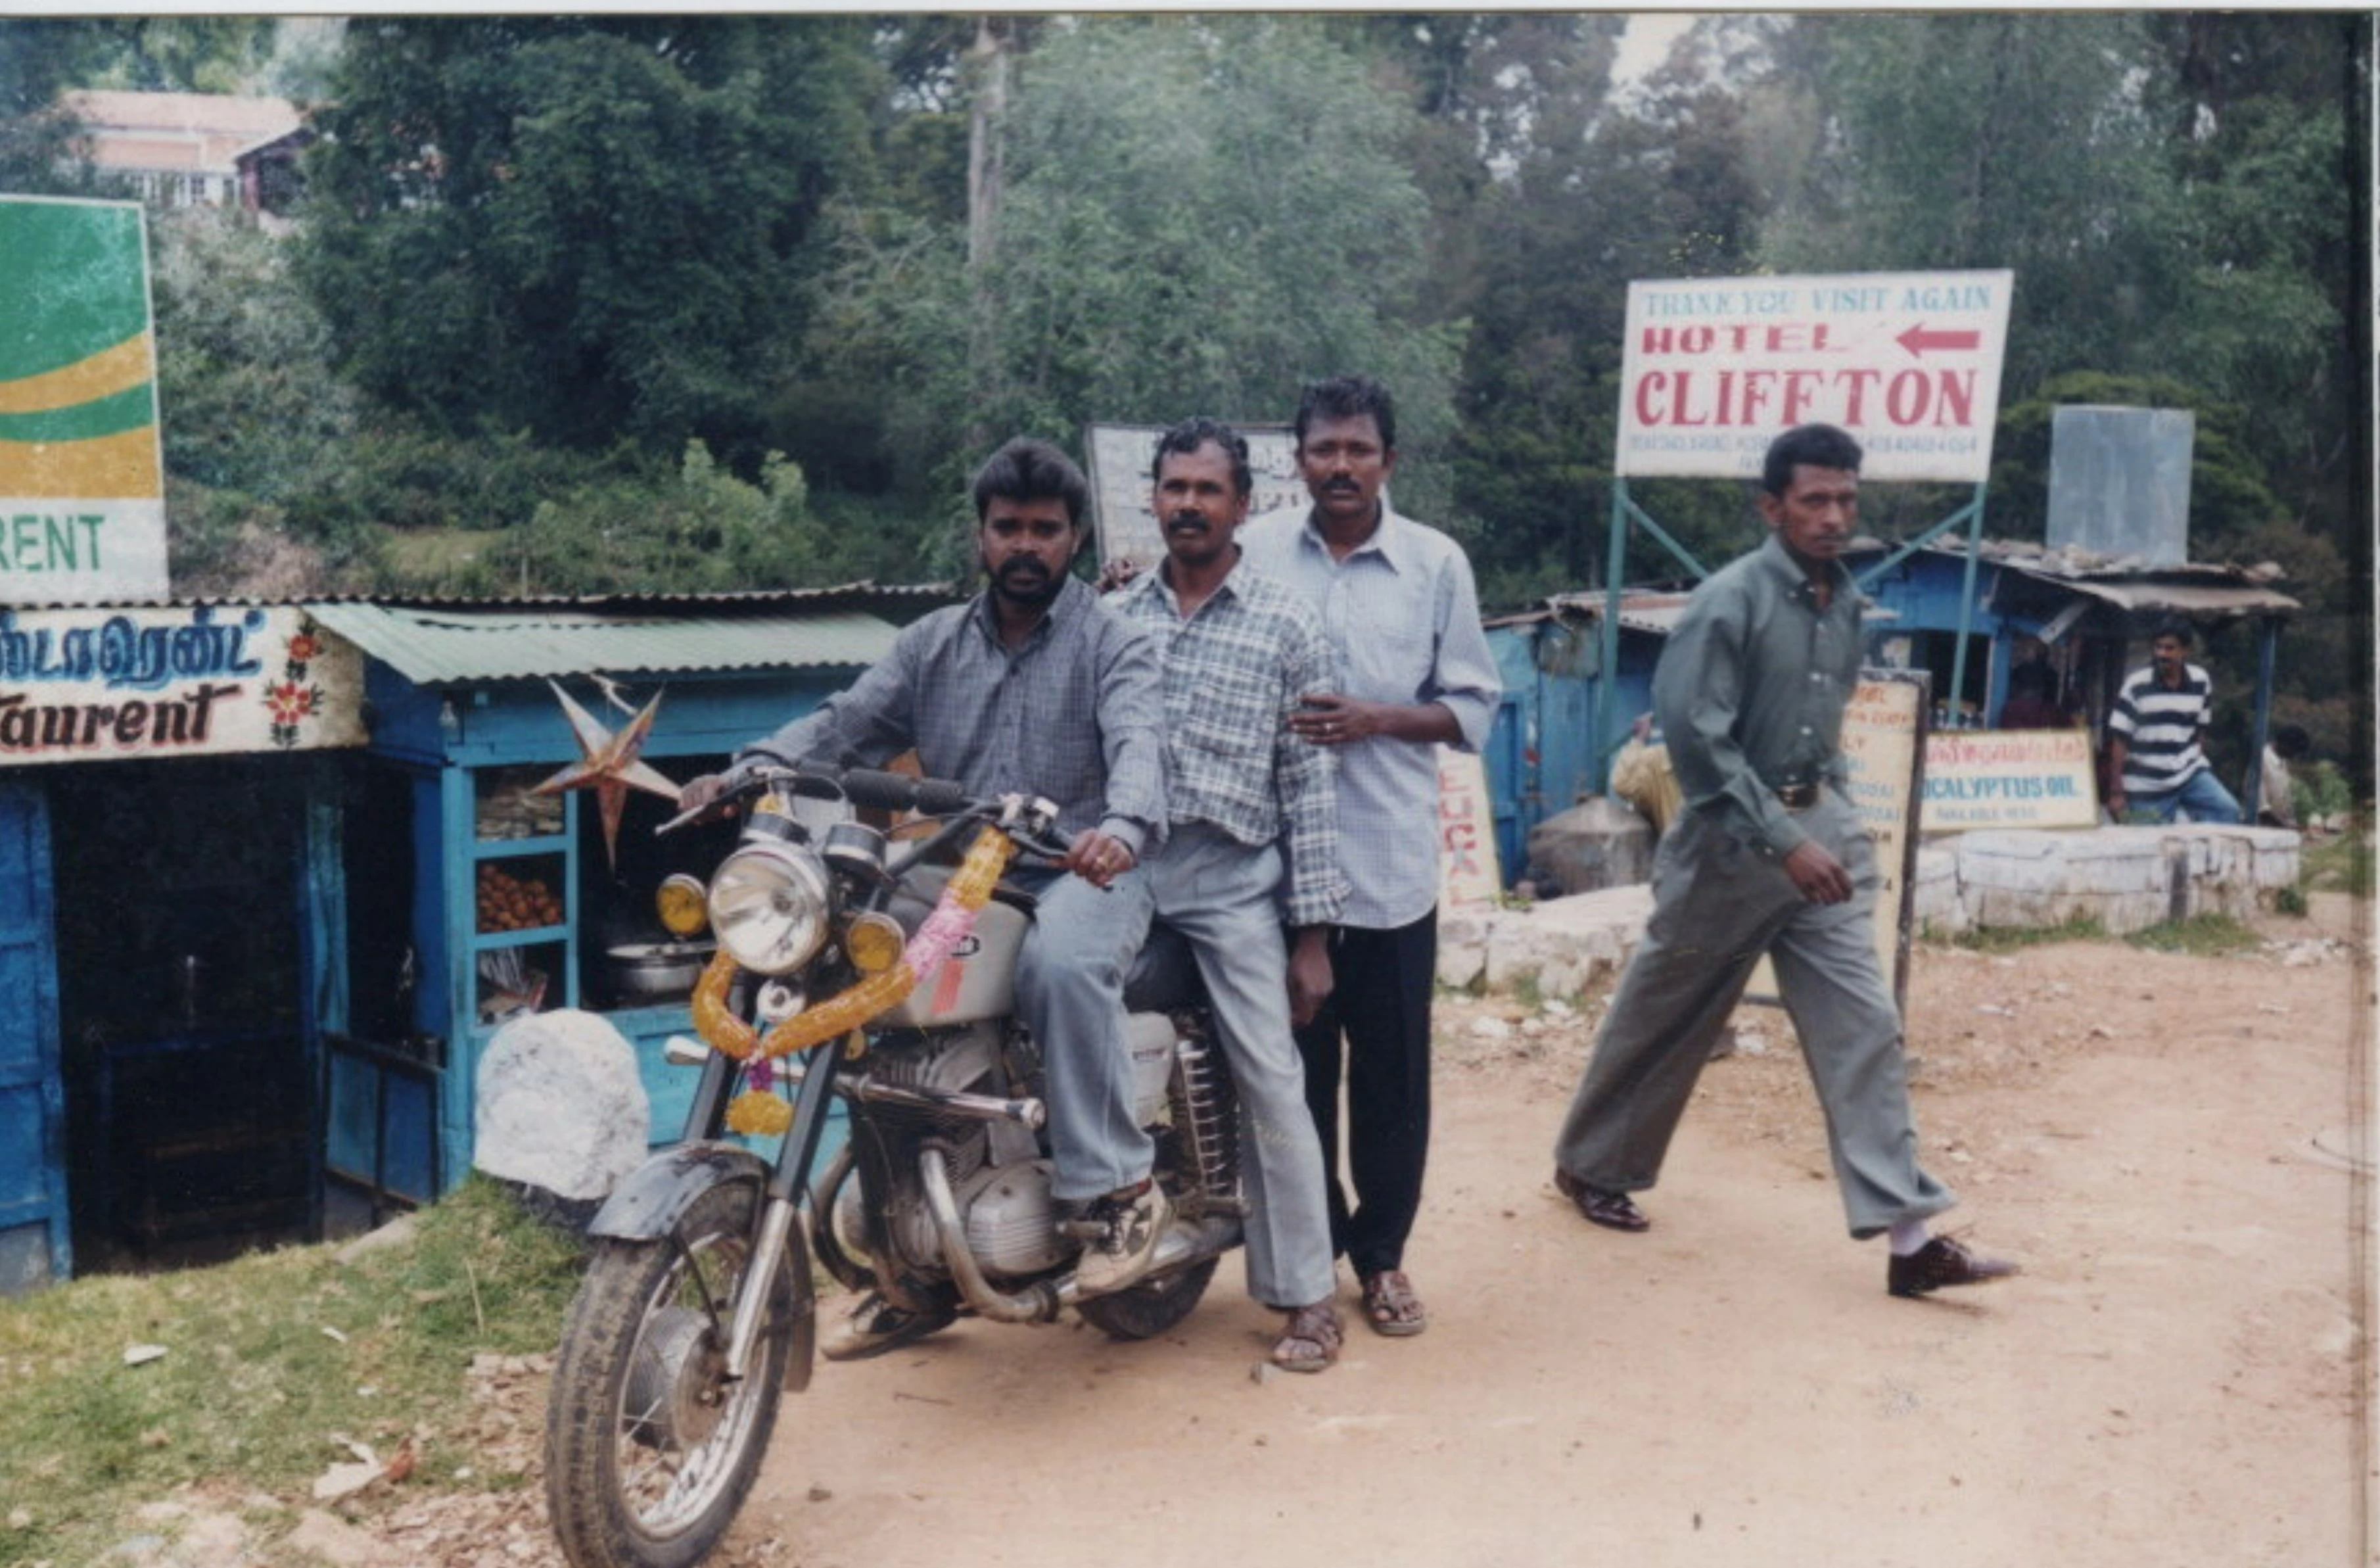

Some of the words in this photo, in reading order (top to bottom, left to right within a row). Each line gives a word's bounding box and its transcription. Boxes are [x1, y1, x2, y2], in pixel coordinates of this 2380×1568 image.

[1645, 291, 1729, 317] THANK
[1811, 287, 1890, 312] VISIT
[1897, 285, 1991, 311] AGAIN
[1641, 322, 1852, 354] HOTEL
